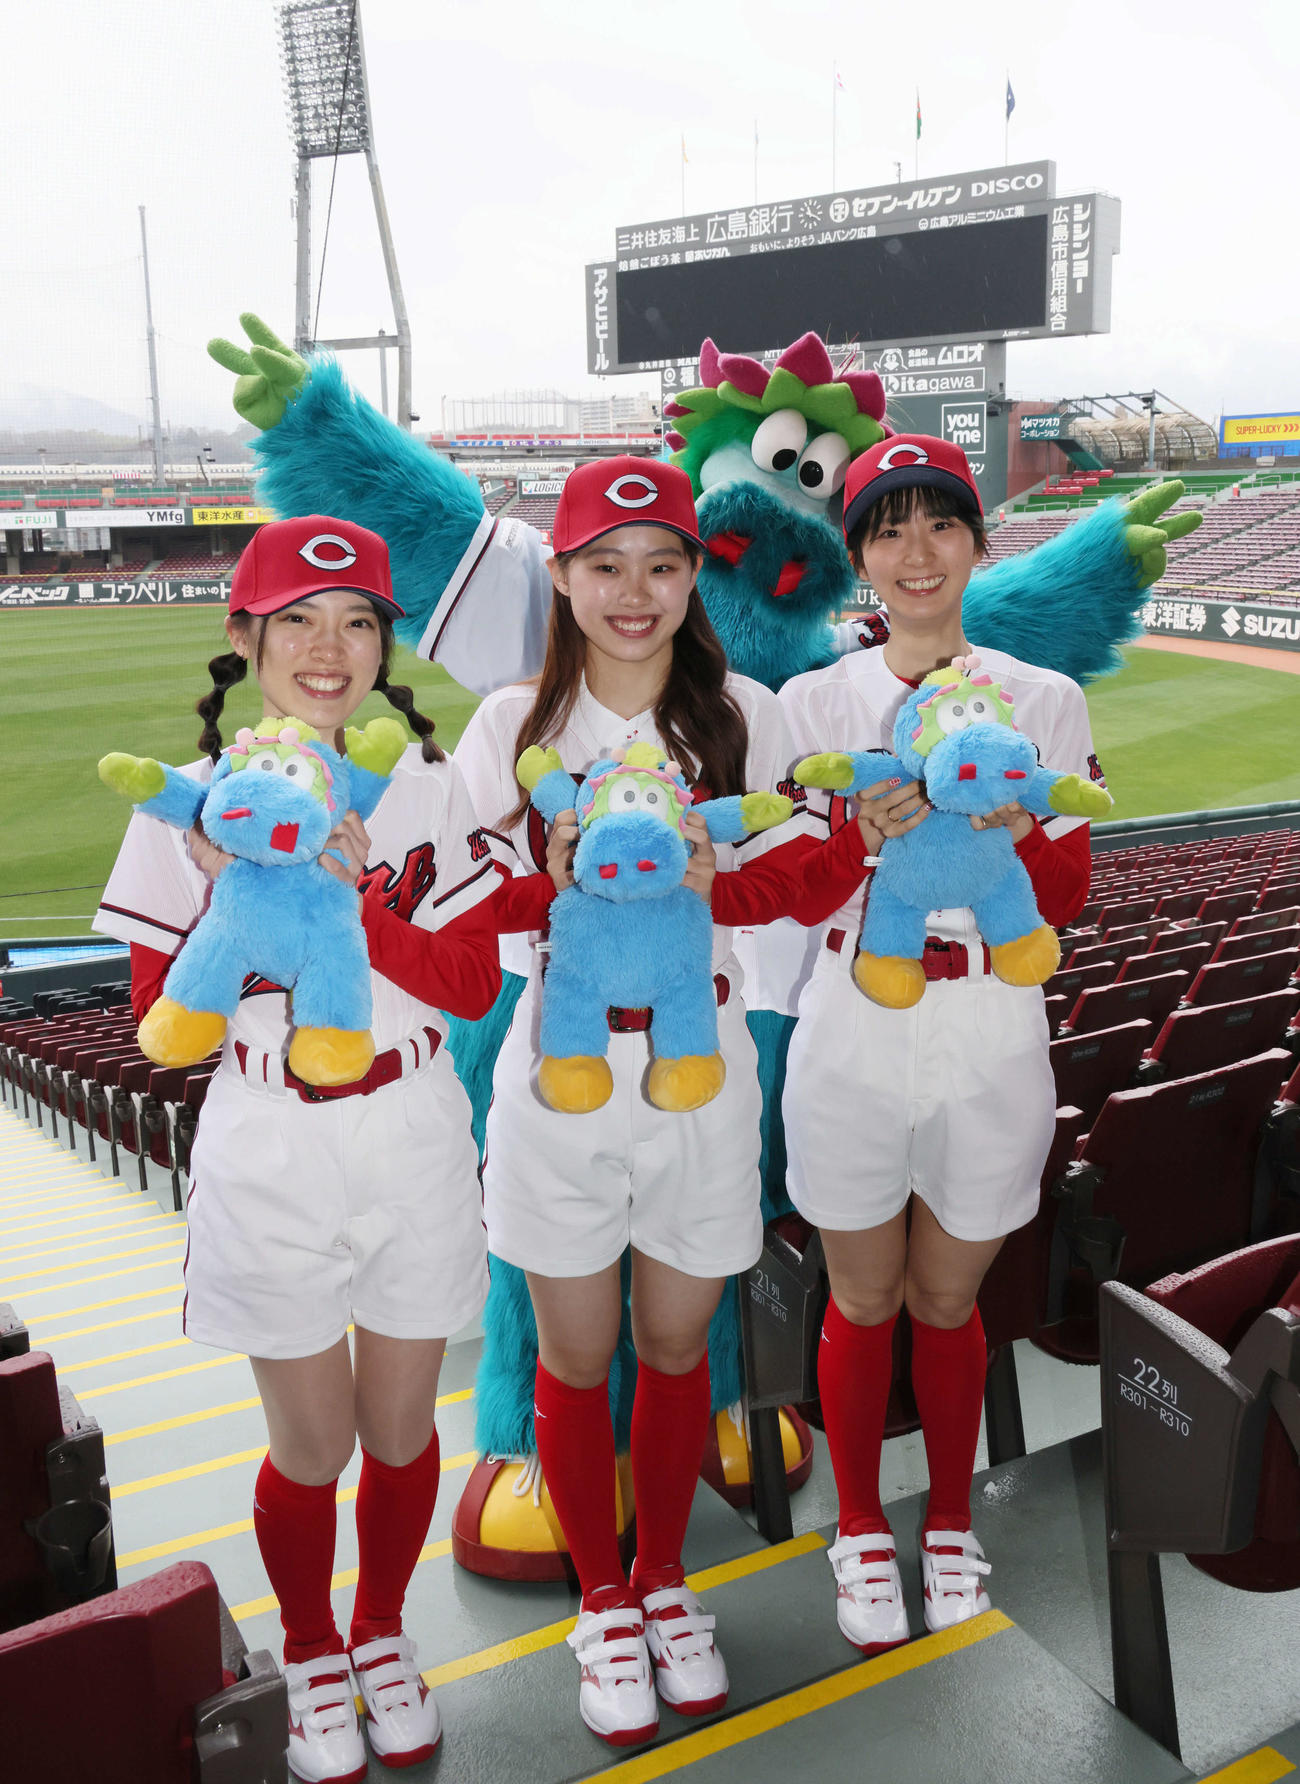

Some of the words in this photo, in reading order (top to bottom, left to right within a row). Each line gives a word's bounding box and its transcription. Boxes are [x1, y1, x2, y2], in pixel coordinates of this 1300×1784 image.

[971, 174, 1044, 197] DISCO
[706, 204, 794, 244] 広島銀行
[930, 205, 1025, 229] 広島アルミニウム工業
[617, 223, 700, 251] 三井住友海上
[750, 233, 815, 254] おもいに、よりそう
[817, 225, 877, 245] JAバンク広島
[1050, 205, 1070, 331] 広島市信用組合
[593, 268, 609, 371] アサヒビール
[937, 343, 984, 365] ムロオ
[947, 413, 980, 432] you
[1021, 428, 1060, 439] コーポレーション
[1031, 417, 1060, 429] マツオカ
[953, 429, 981, 444] me
[25, 515, 53, 525] FUJI
[146, 511, 184, 524] YMfg
[197, 510, 244, 522] 東洋水産
[102, 582, 177, 603] ユウベル
[1141, 601, 1207, 632] 東洋証券
[755, 1269, 780, 1301] 21列
[1133, 1358, 1178, 1405] 22列
